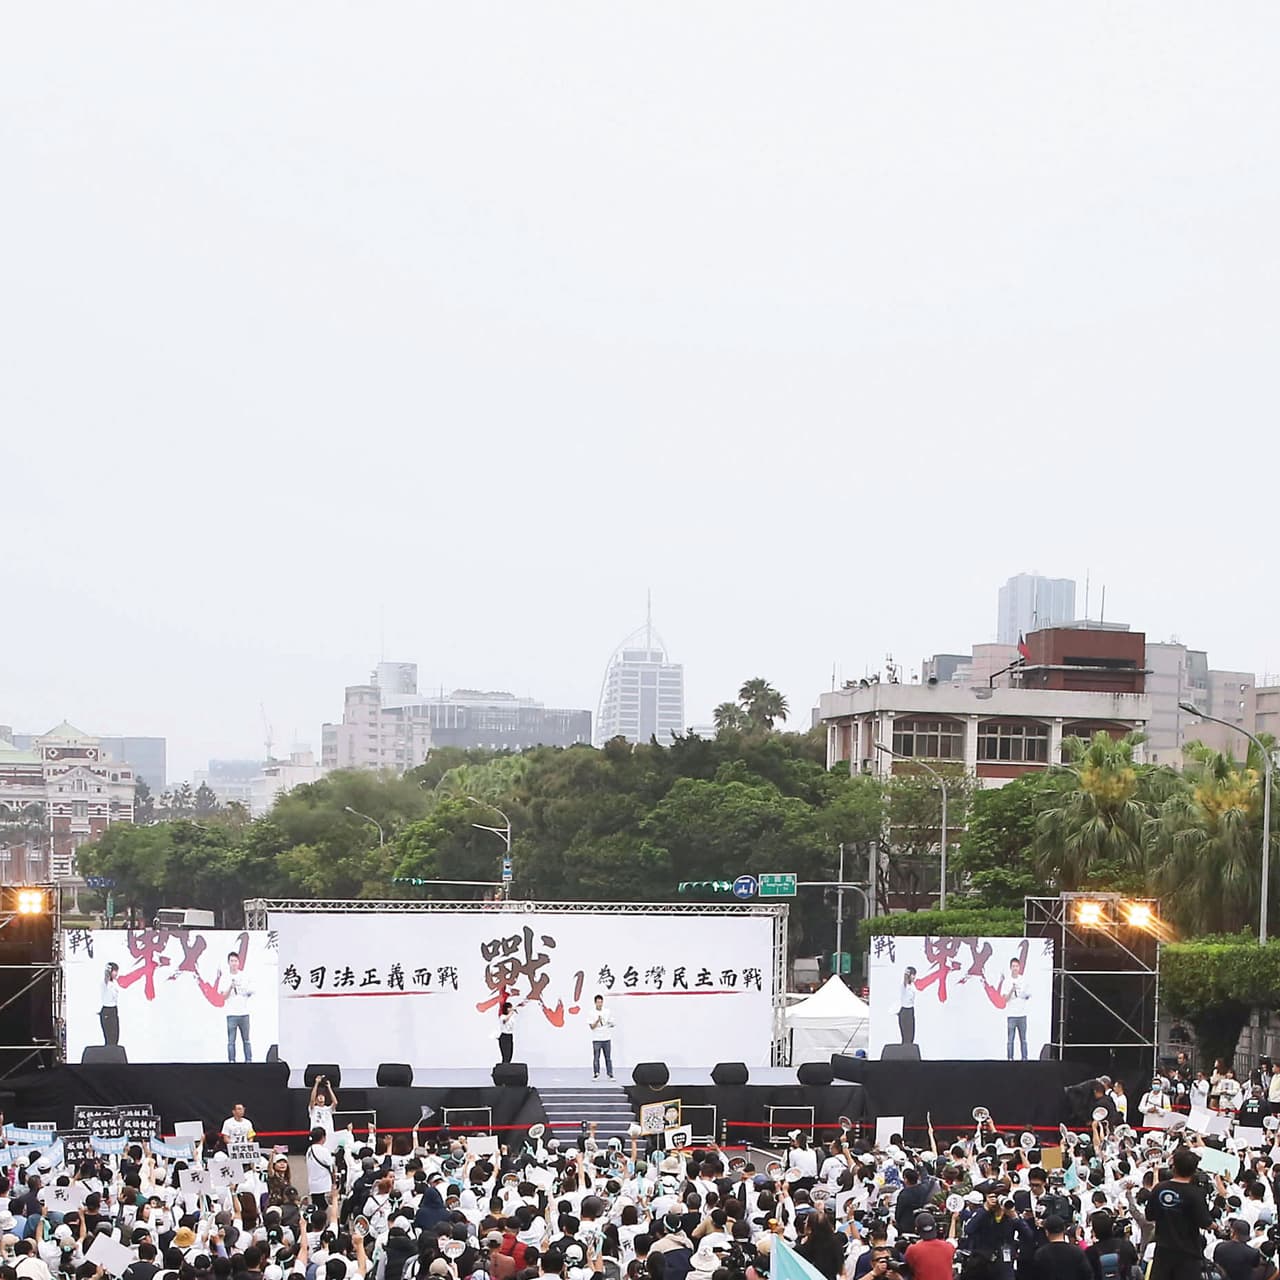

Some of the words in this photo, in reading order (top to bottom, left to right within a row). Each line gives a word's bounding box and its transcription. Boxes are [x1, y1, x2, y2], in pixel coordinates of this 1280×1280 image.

[281, 963, 459, 991] 為司法正義而戰
[597, 964, 762, 991] 為台灣民主而戰
